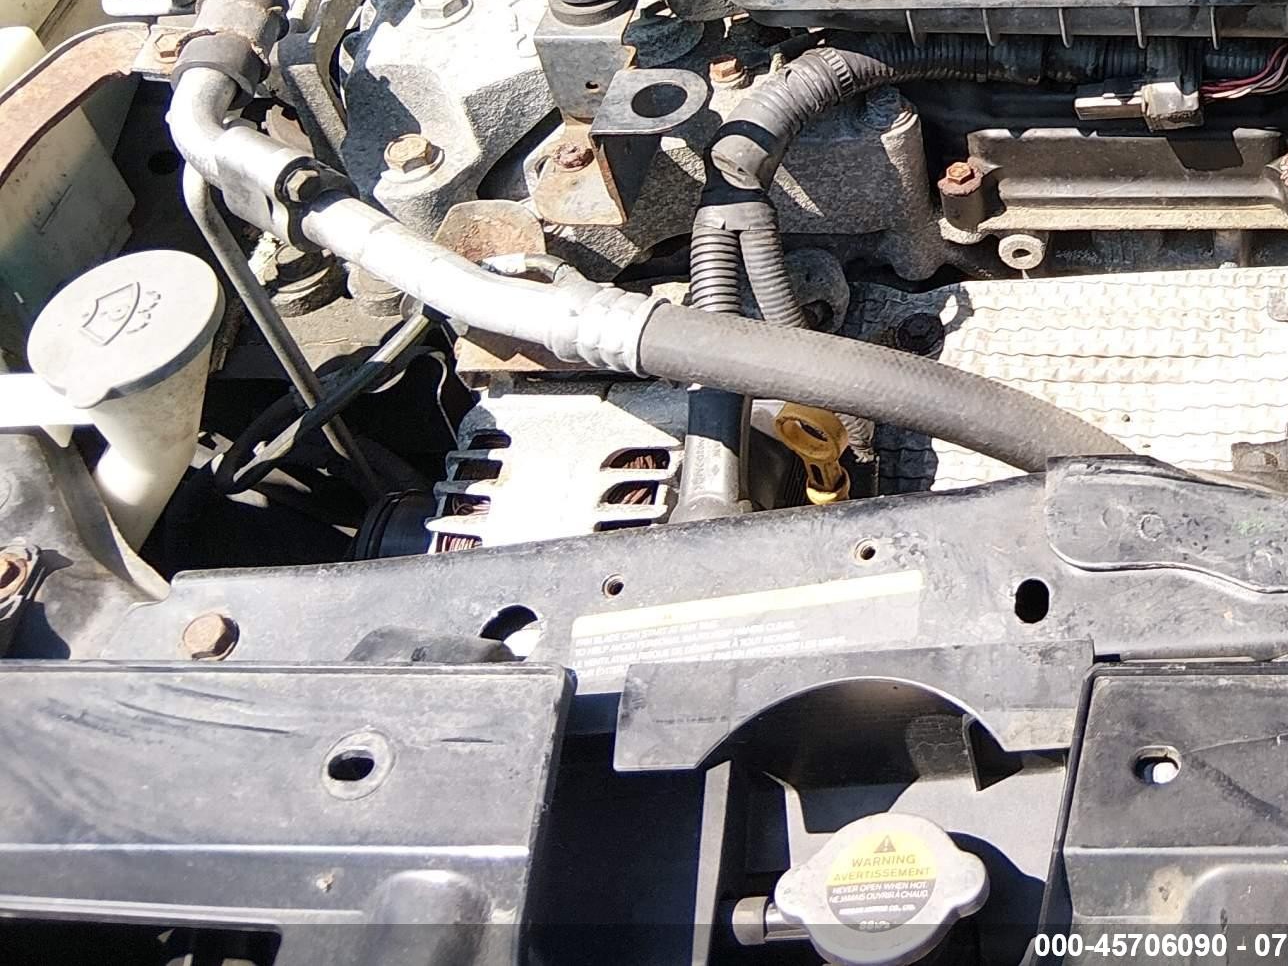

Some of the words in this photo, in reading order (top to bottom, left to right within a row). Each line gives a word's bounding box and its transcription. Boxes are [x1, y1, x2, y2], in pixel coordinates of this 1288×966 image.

[852, 854, 916, 868] WARNING
[833, 867, 930, 882] AVERTISSEMENT
[832, 885, 859, 894] NEVER
[861, 883, 882, 892] OPEN
[883, 882, 908, 891] WHEN
